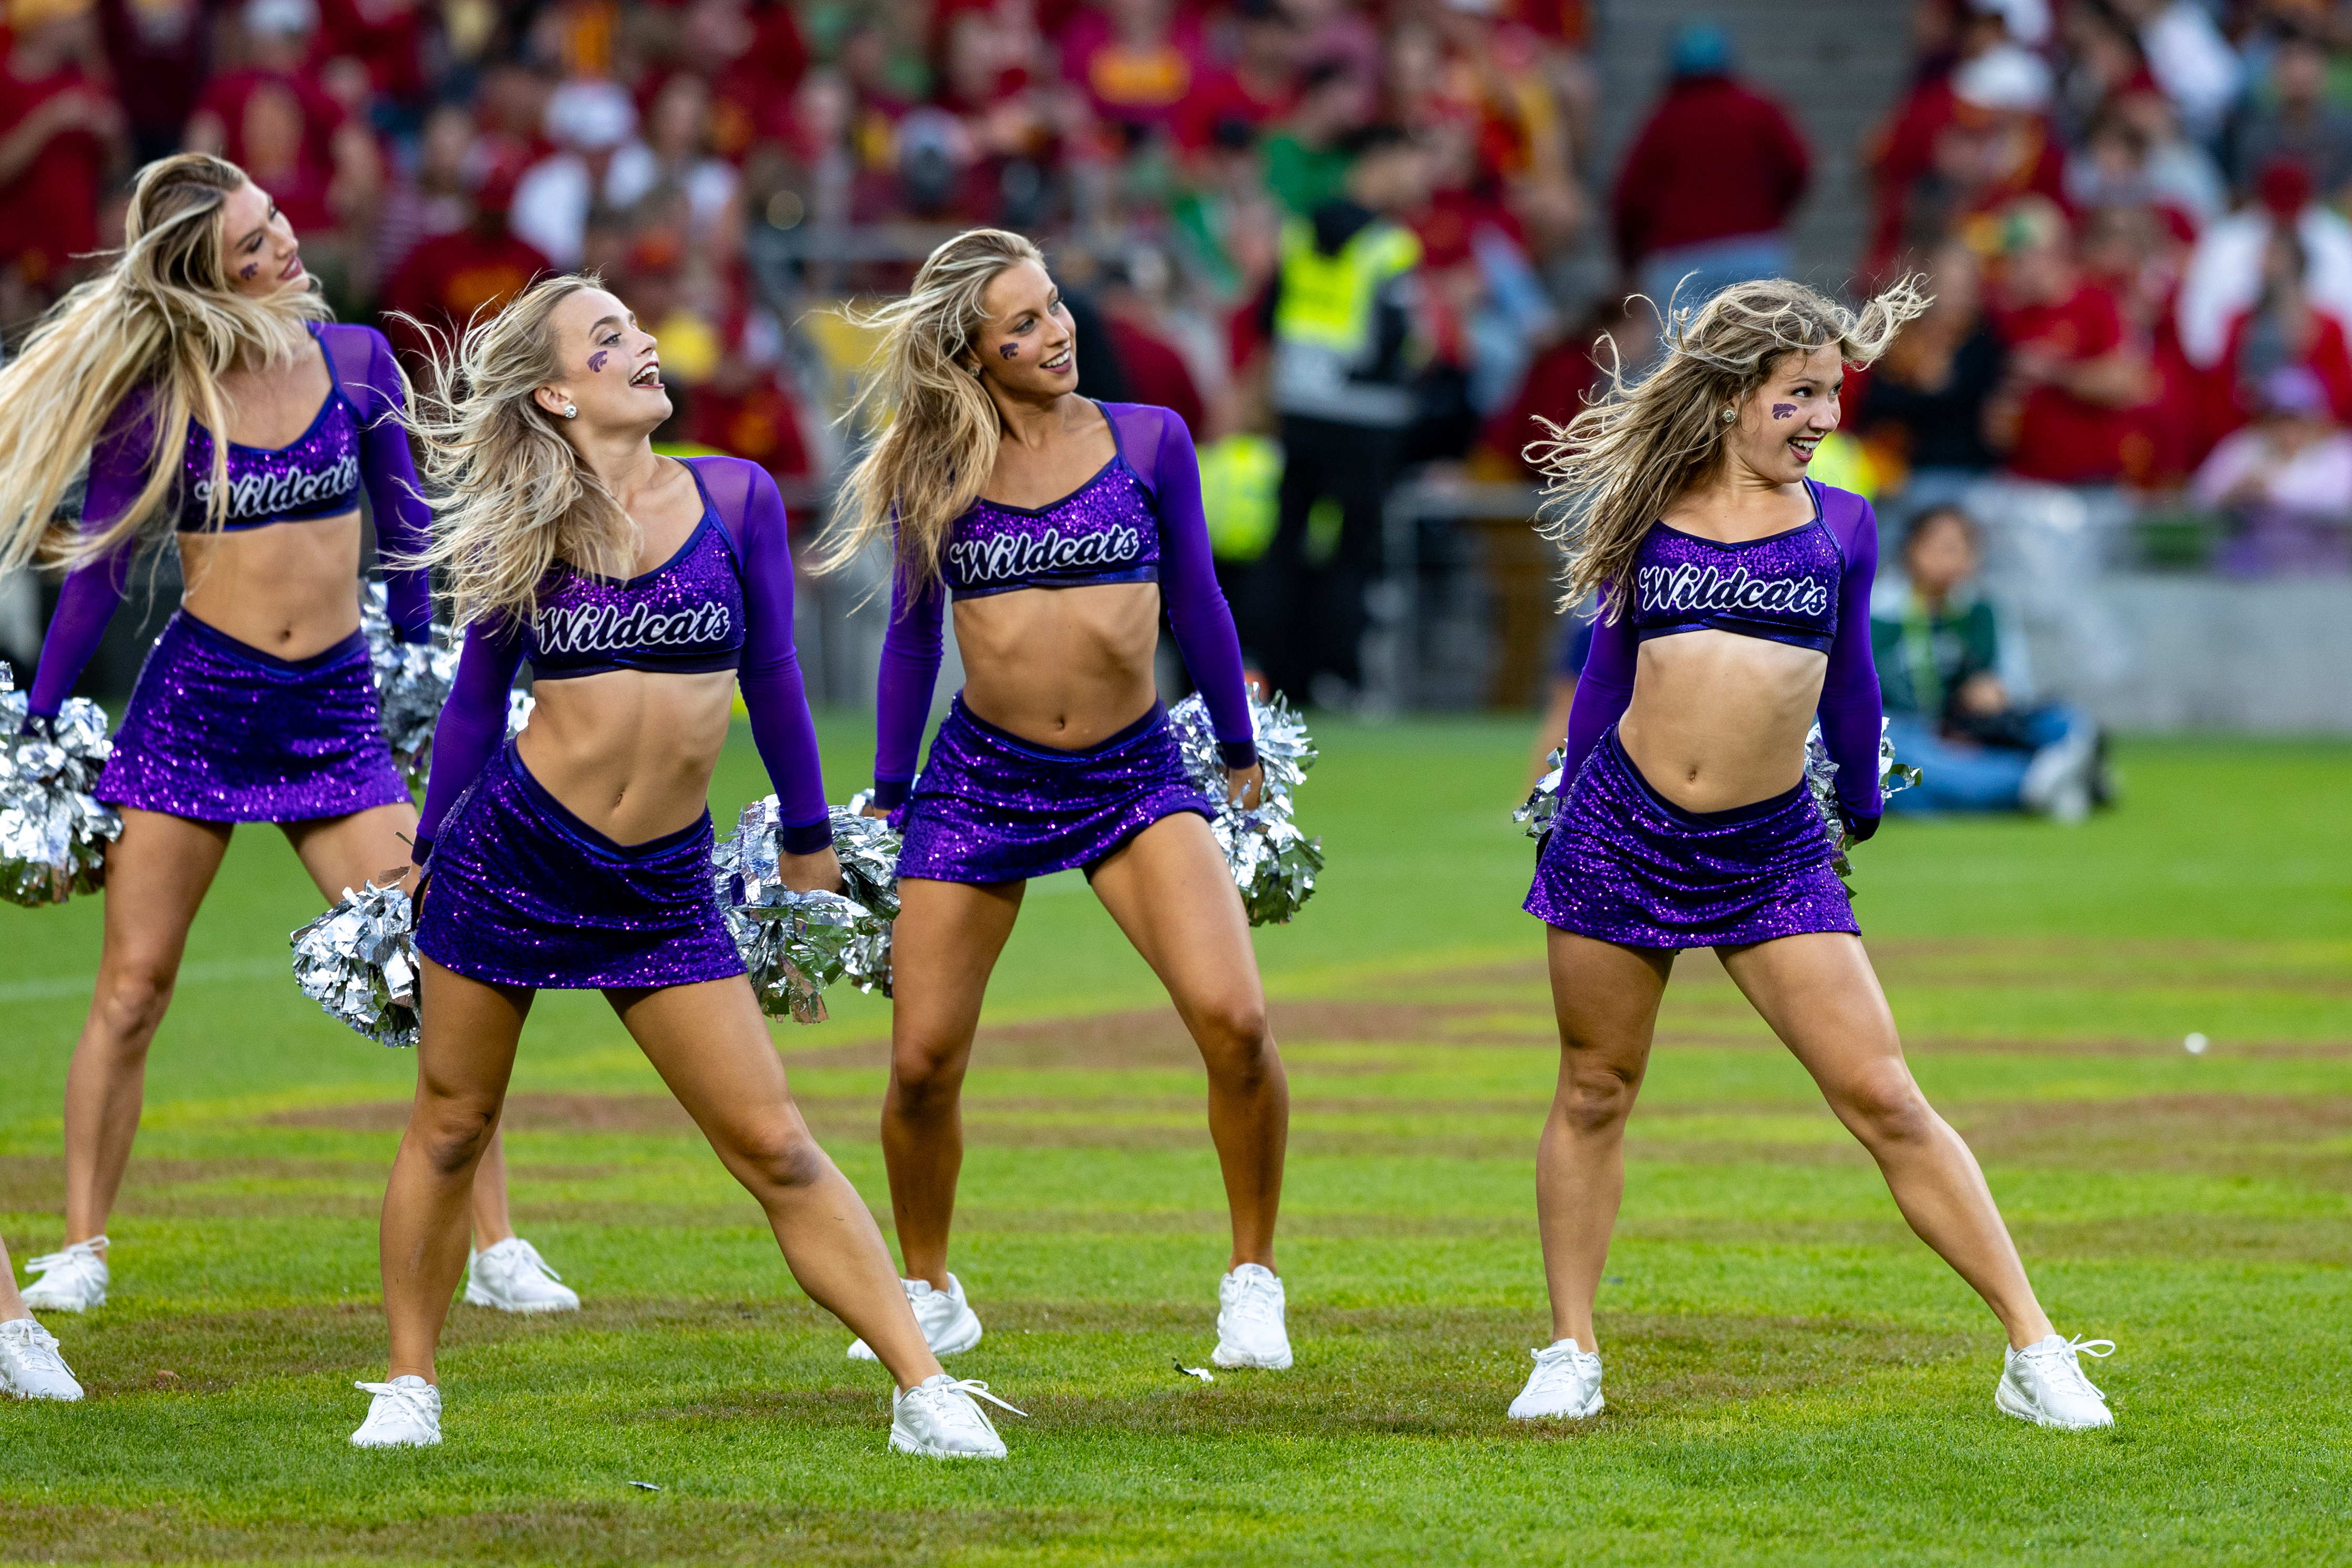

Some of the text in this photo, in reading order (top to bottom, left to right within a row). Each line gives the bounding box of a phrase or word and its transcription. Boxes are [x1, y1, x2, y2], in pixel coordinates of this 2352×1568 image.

[950, 524, 1139, 584] Wildcats
[1639, 563, 1827, 616] Wildcats
[533, 601, 731, 655] Wildcats
